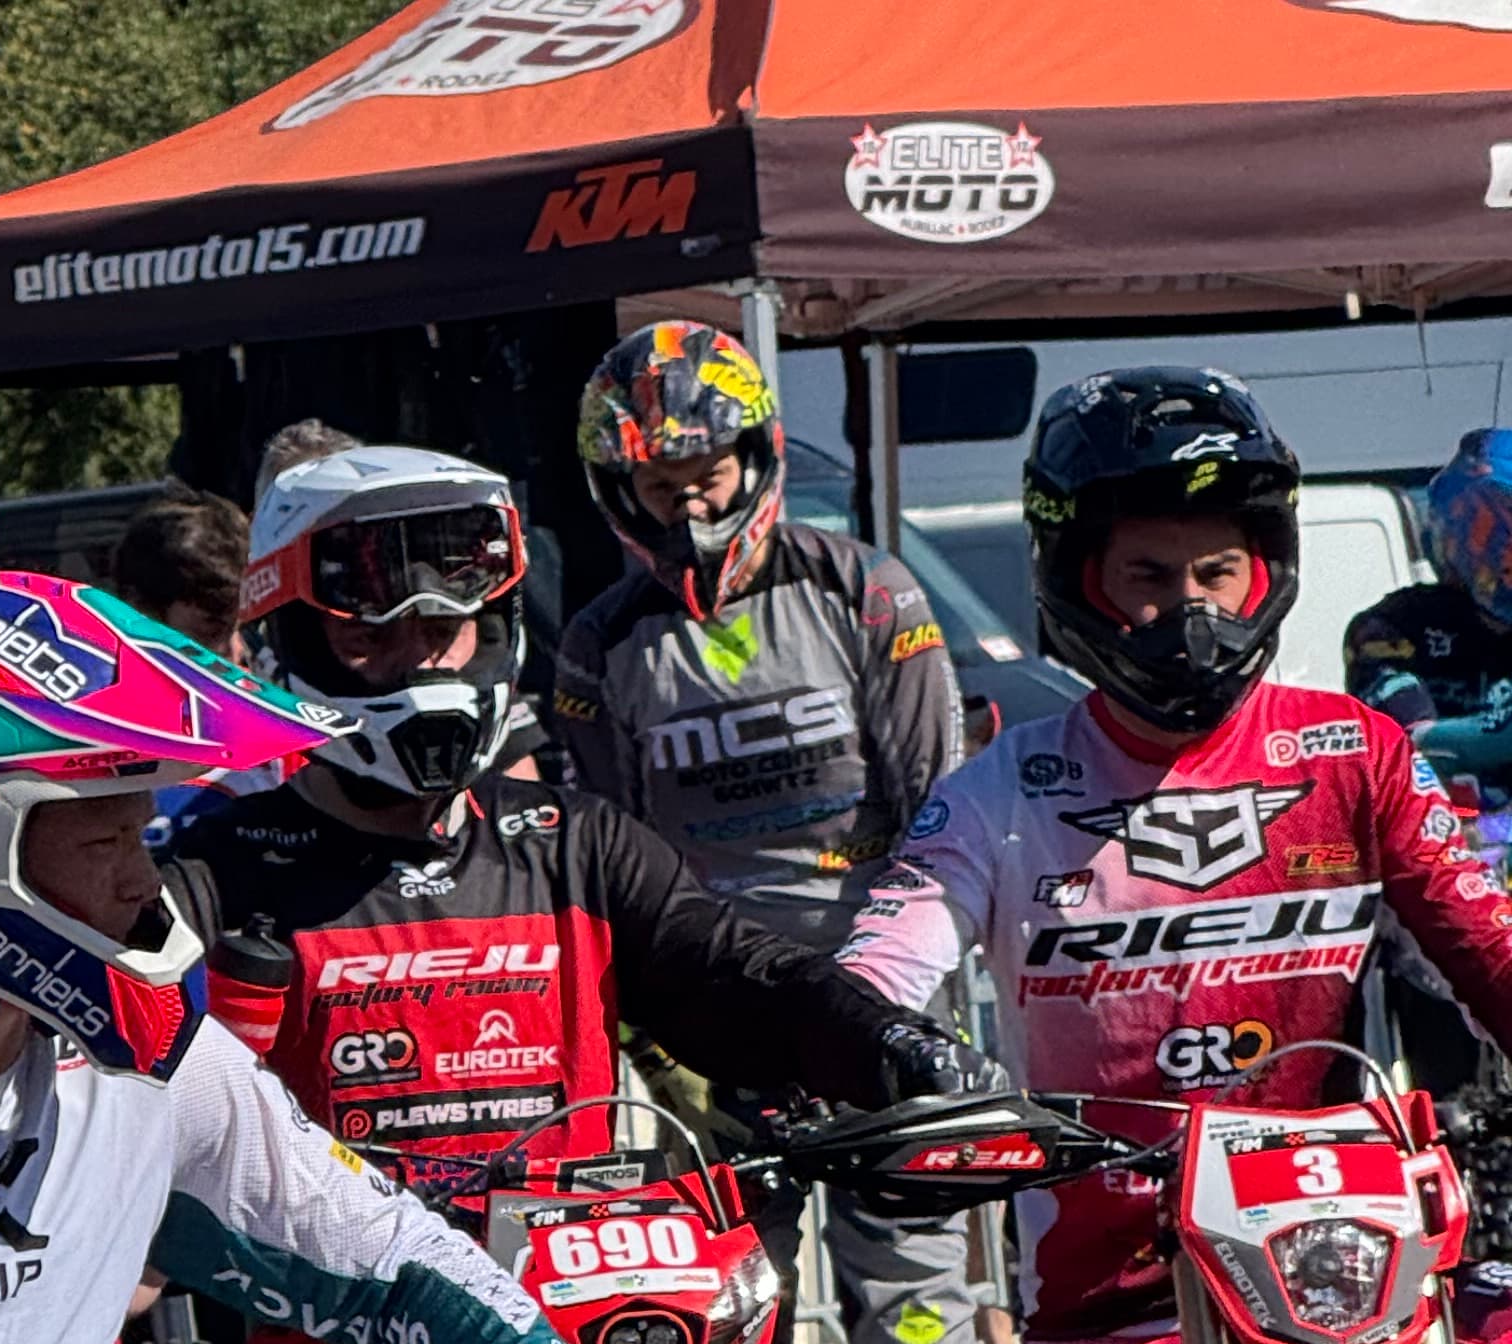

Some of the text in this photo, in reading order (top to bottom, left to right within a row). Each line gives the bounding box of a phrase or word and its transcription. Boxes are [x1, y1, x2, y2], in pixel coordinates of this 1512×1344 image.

[891, 135, 1003, 170] ELITE
[525, 158, 696, 254] KTM
[864, 174, 1038, 212] MOTO
[16, 217, 427, 303] elitemoto15.com
[1026, 887, 1381, 967] RIEJU
[317, 944, 561, 989] RIEJU
[331, 1031, 418, 1077] GRO
[435, 1046, 560, 1077] EUROTEK
[1156, 1020, 1274, 1080] GRO
[375, 1094, 556, 1131] PLEWS TYRES
[926, 1147, 1041, 1167] REJU
[1292, 1147, 1344, 1197] 3
[547, 1217, 699, 1277] 690
[1213, 1241, 1278, 1327] EUROTEK
